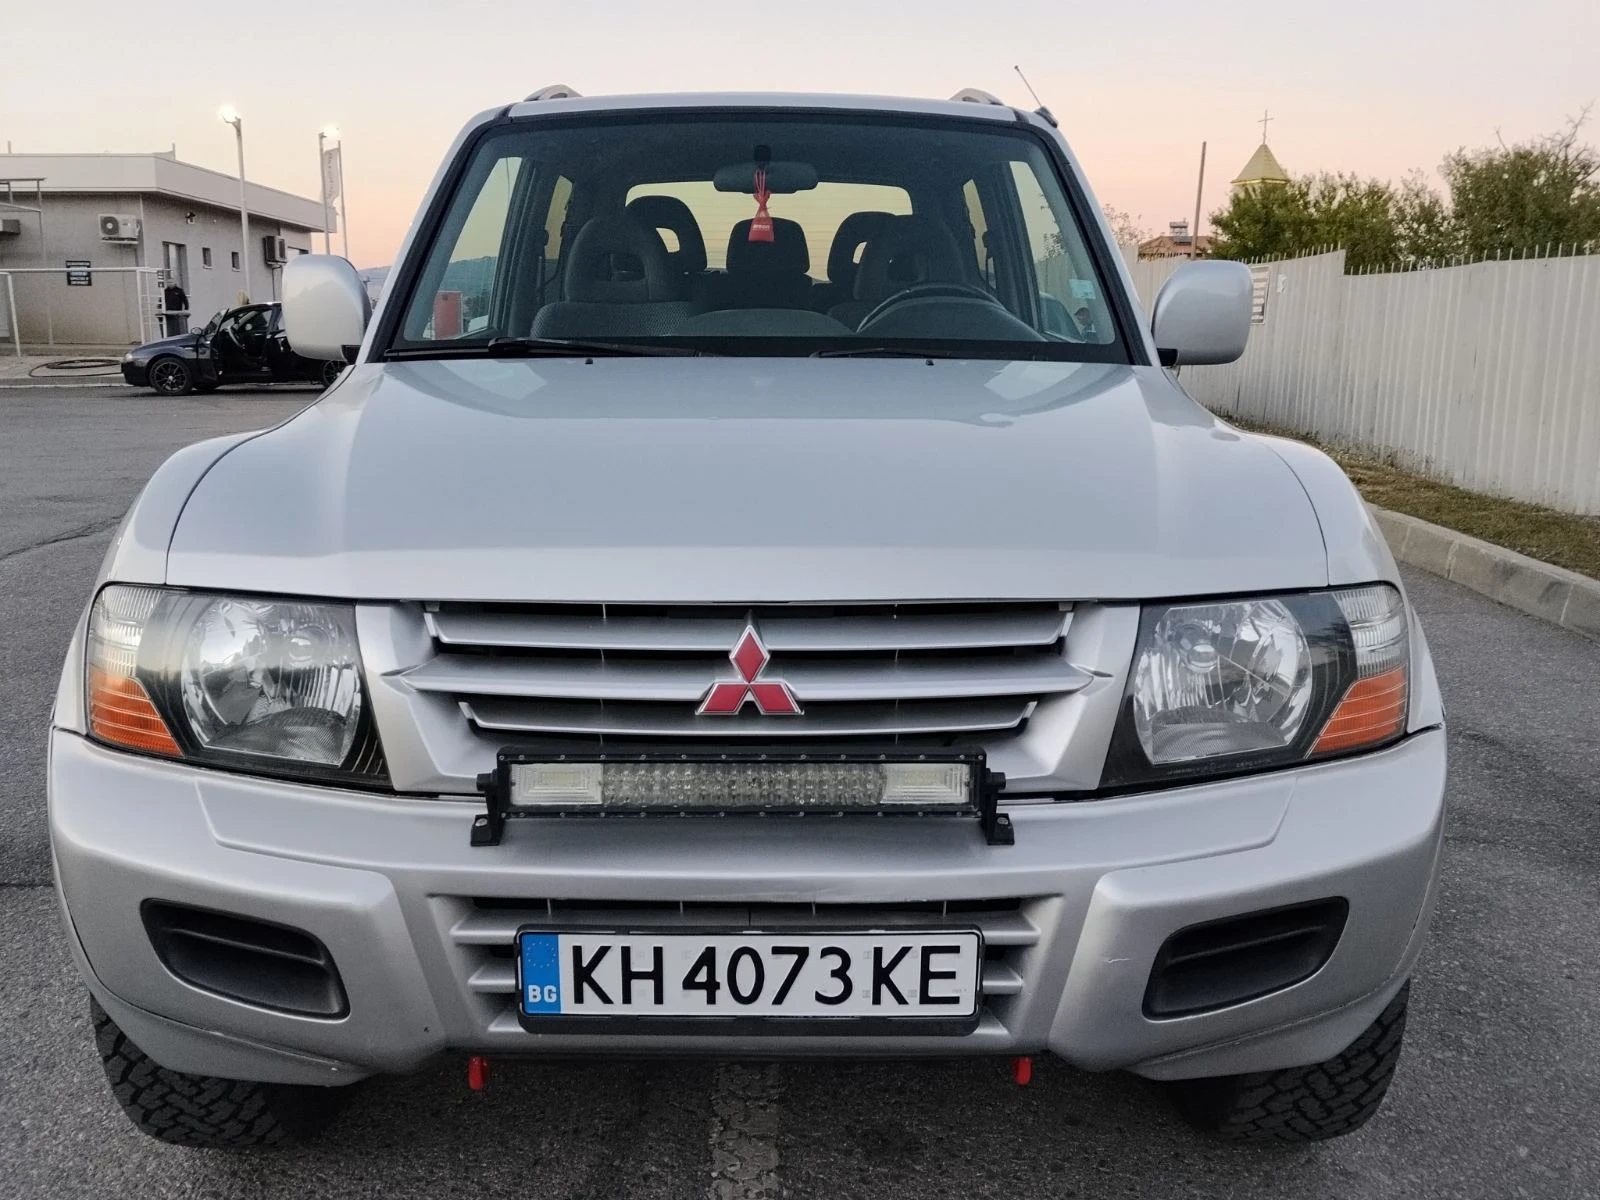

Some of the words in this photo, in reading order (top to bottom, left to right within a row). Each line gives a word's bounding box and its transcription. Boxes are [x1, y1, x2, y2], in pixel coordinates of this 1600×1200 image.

[528, 985, 557, 1003] BG
[573, 945, 664, 1005] KH
[682, 945, 853, 1006] 4073
[872, 945, 961, 1005] KE
